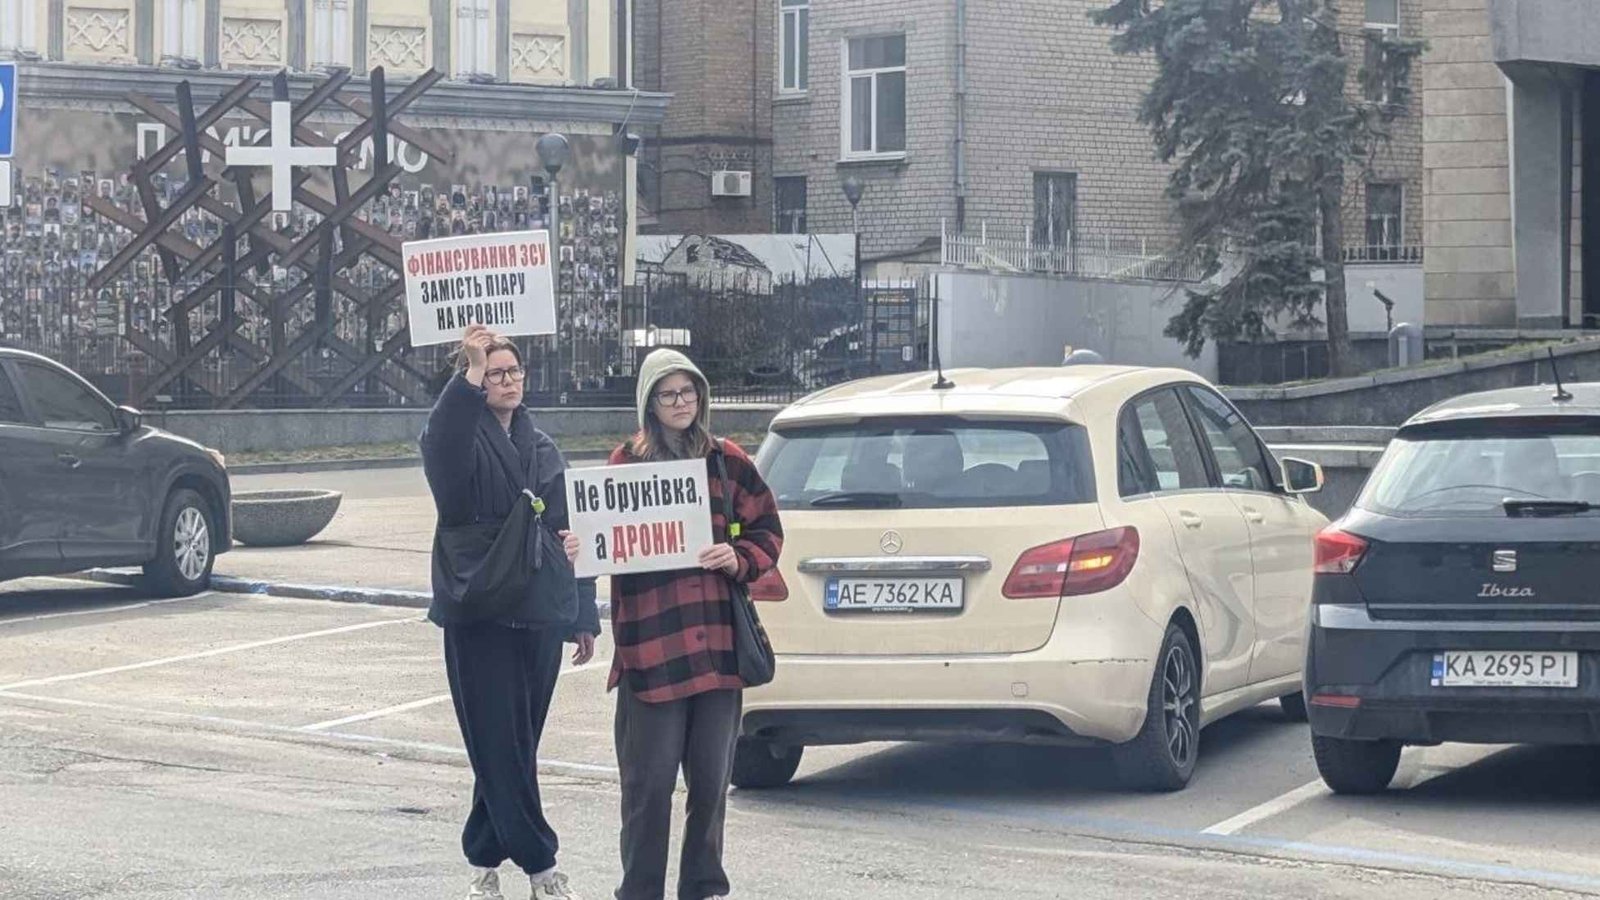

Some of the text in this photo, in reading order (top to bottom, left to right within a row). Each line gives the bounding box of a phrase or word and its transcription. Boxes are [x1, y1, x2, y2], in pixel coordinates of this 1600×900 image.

[408, 243, 546, 277] ФІНАНСУВАННЯ ЗСУ
[421, 272, 526, 304] ЗАМІСТЬ ПІАРУ
[436, 301, 515, 330] НА КРОВІ!!!
[573, 474, 702, 513] Не бруківка,
[595, 521, 685, 564] а ДРОНИ!
[839, 583, 954, 604] AE 7362 KA
[1477, 583, 1536, 597] Ibiza
[1446, 654, 1477, 677] KA
[1483, 654, 1534, 677] 2695
